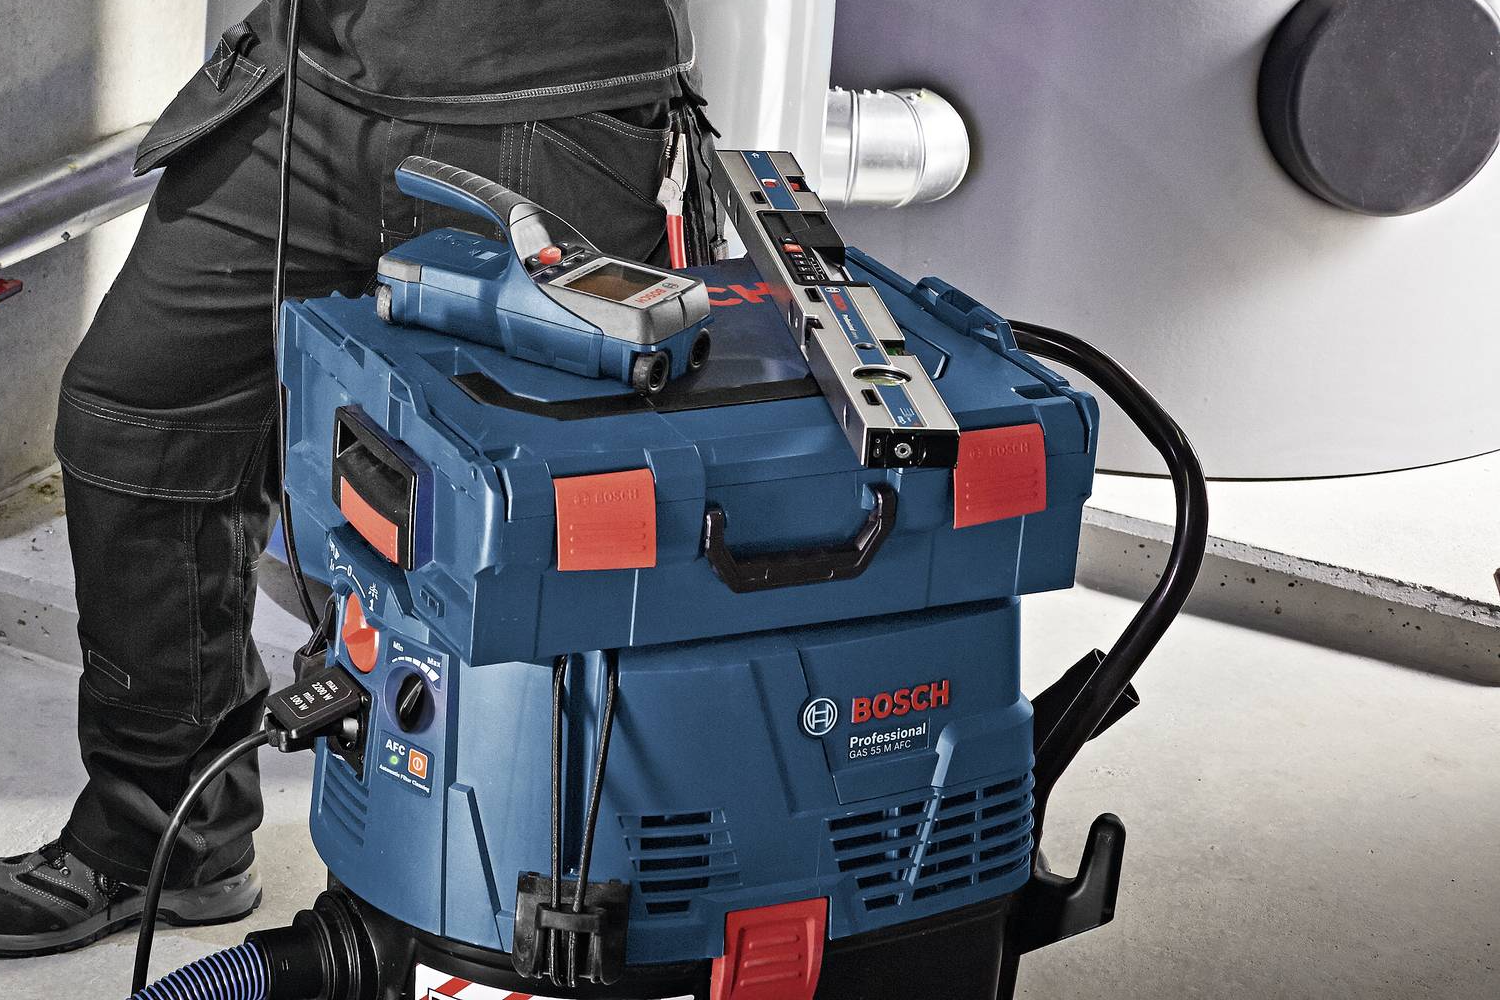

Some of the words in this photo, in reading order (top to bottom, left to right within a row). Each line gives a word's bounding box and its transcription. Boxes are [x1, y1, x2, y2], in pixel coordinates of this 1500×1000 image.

[635, 288, 667, 304] BOSCH
[986, 442, 1030, 457] BOSCH
[595, 488, 639, 504] BOSCH
[347, 564, 353, 577] 0
[368, 598, 374, 612] 1
[392, 640, 404, 652] Min
[426, 656, 441, 668] Max
[311, 681, 328, 696] 2200
[322, 692, 334, 701] W
[325, 679, 339, 693] max.
[289, 694, 304, 706] 100
[298, 702, 310, 711] W
[302, 691, 316, 704] min.
[851, 679, 949, 724] BOSCH
[849, 721, 927, 749] Professional
[385, 738, 406, 756] AFC
[849, 747, 869, 760] GAS
[870, 744, 882, 756] 55
[883, 743, 893, 753] M
[893, 738, 912, 751] AFC
[379, 764, 401, 778] Automatic
[400, 774, 412, 784] Filter
